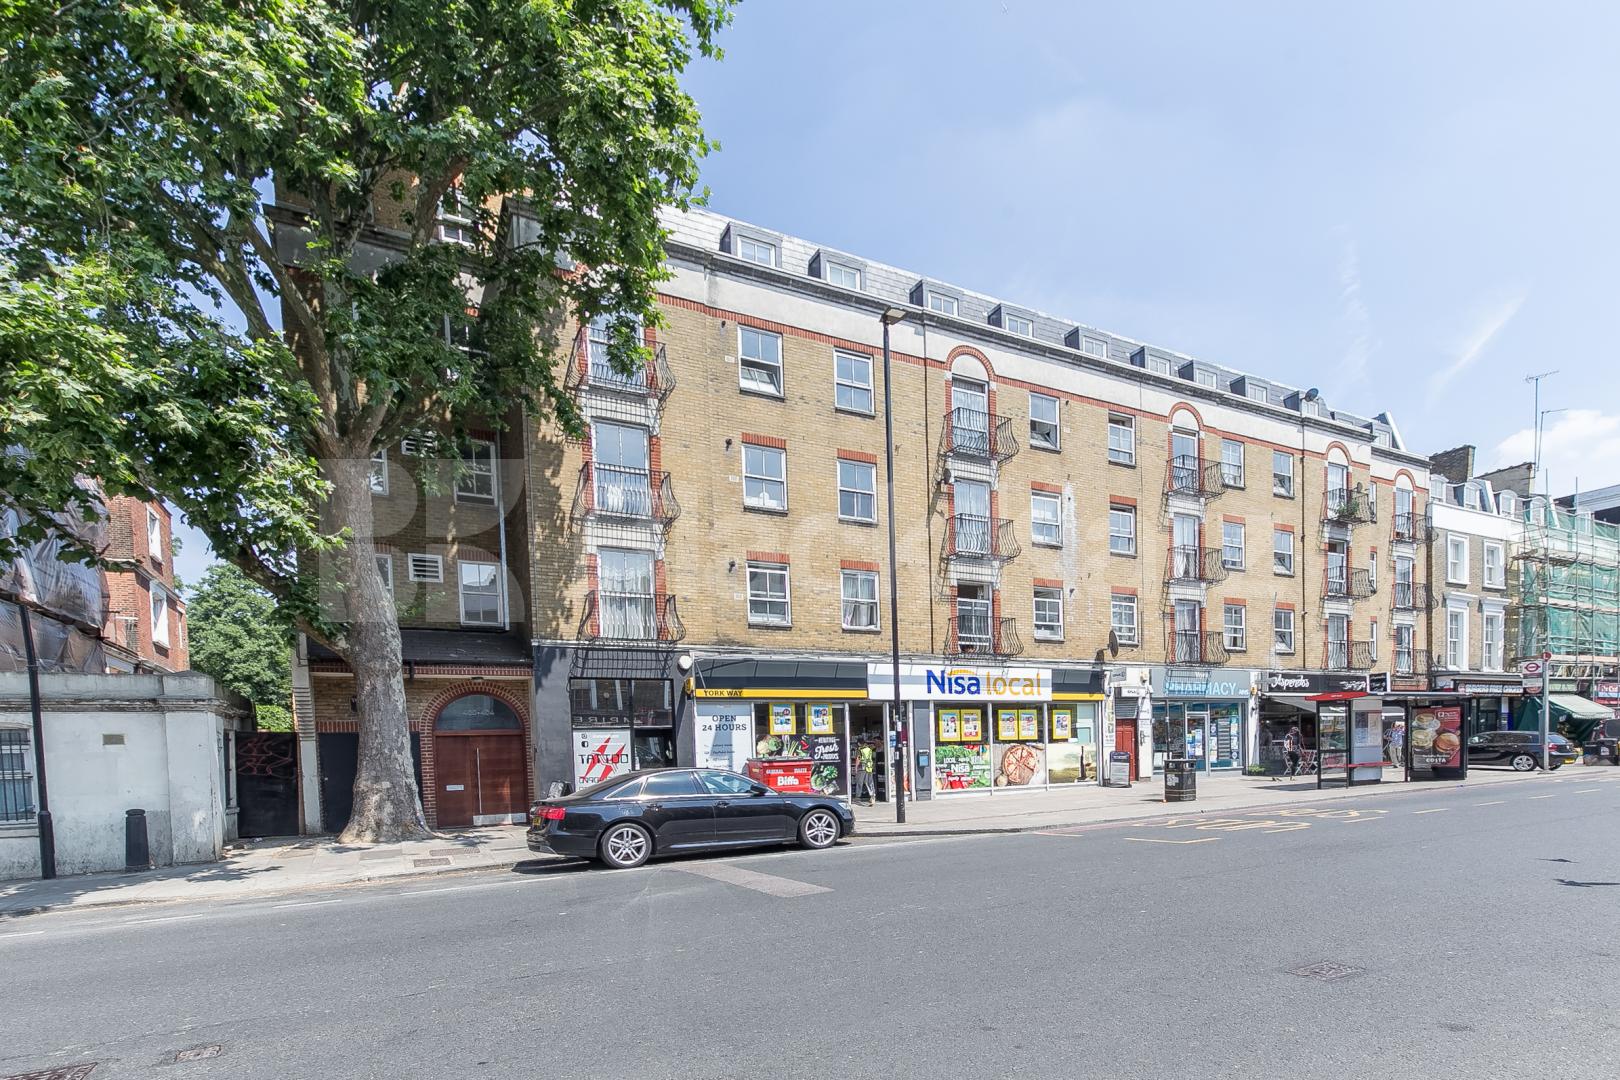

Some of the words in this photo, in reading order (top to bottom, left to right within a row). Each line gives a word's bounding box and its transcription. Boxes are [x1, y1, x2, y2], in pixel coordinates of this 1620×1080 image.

[926, 669, 980, 695] Nisa
[986, 671, 1042, 696] local
[1166, 682, 1236, 696] PHARMACY
[579, 754, 629, 764] TATTOO
[814, 744, 839, 760] Fresh
[777, 776, 799, 786] Biffa
